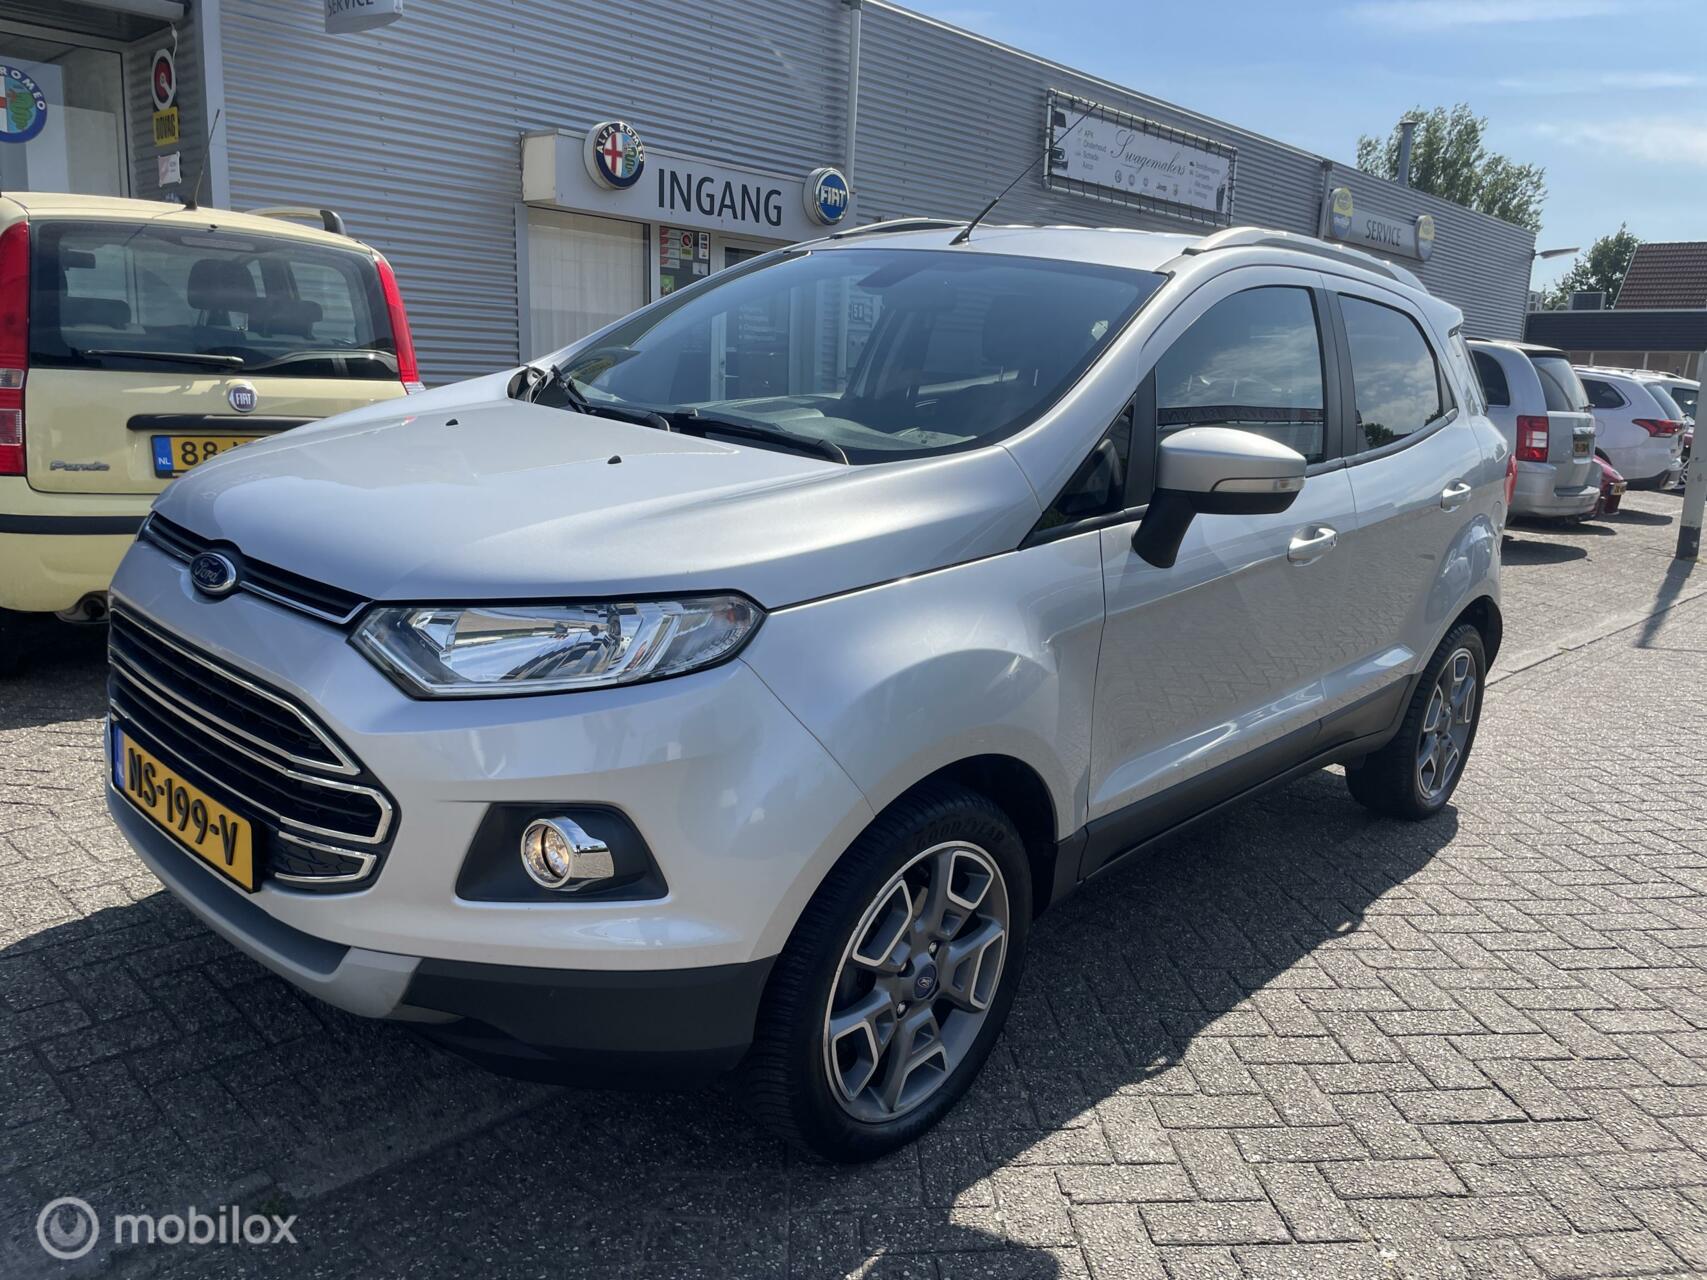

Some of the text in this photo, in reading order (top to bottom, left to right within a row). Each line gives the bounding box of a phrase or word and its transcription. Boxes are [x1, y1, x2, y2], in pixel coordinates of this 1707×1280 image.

[596, 123, 645, 163] ALFA ROMEO
[1110, 129, 1187, 177] Swagemakers
[658, 168, 783, 226] INGANG
[819, 186, 847, 207] FIAT
[1365, 219, 1402, 247] SERVICE
[235, 392, 251, 407] FIAT
[49, 461, 110, 472] Panda
[158, 456, 171, 465] NL
[193, 559, 222, 584] Ford
[128, 747, 239, 866] NS-199-V
